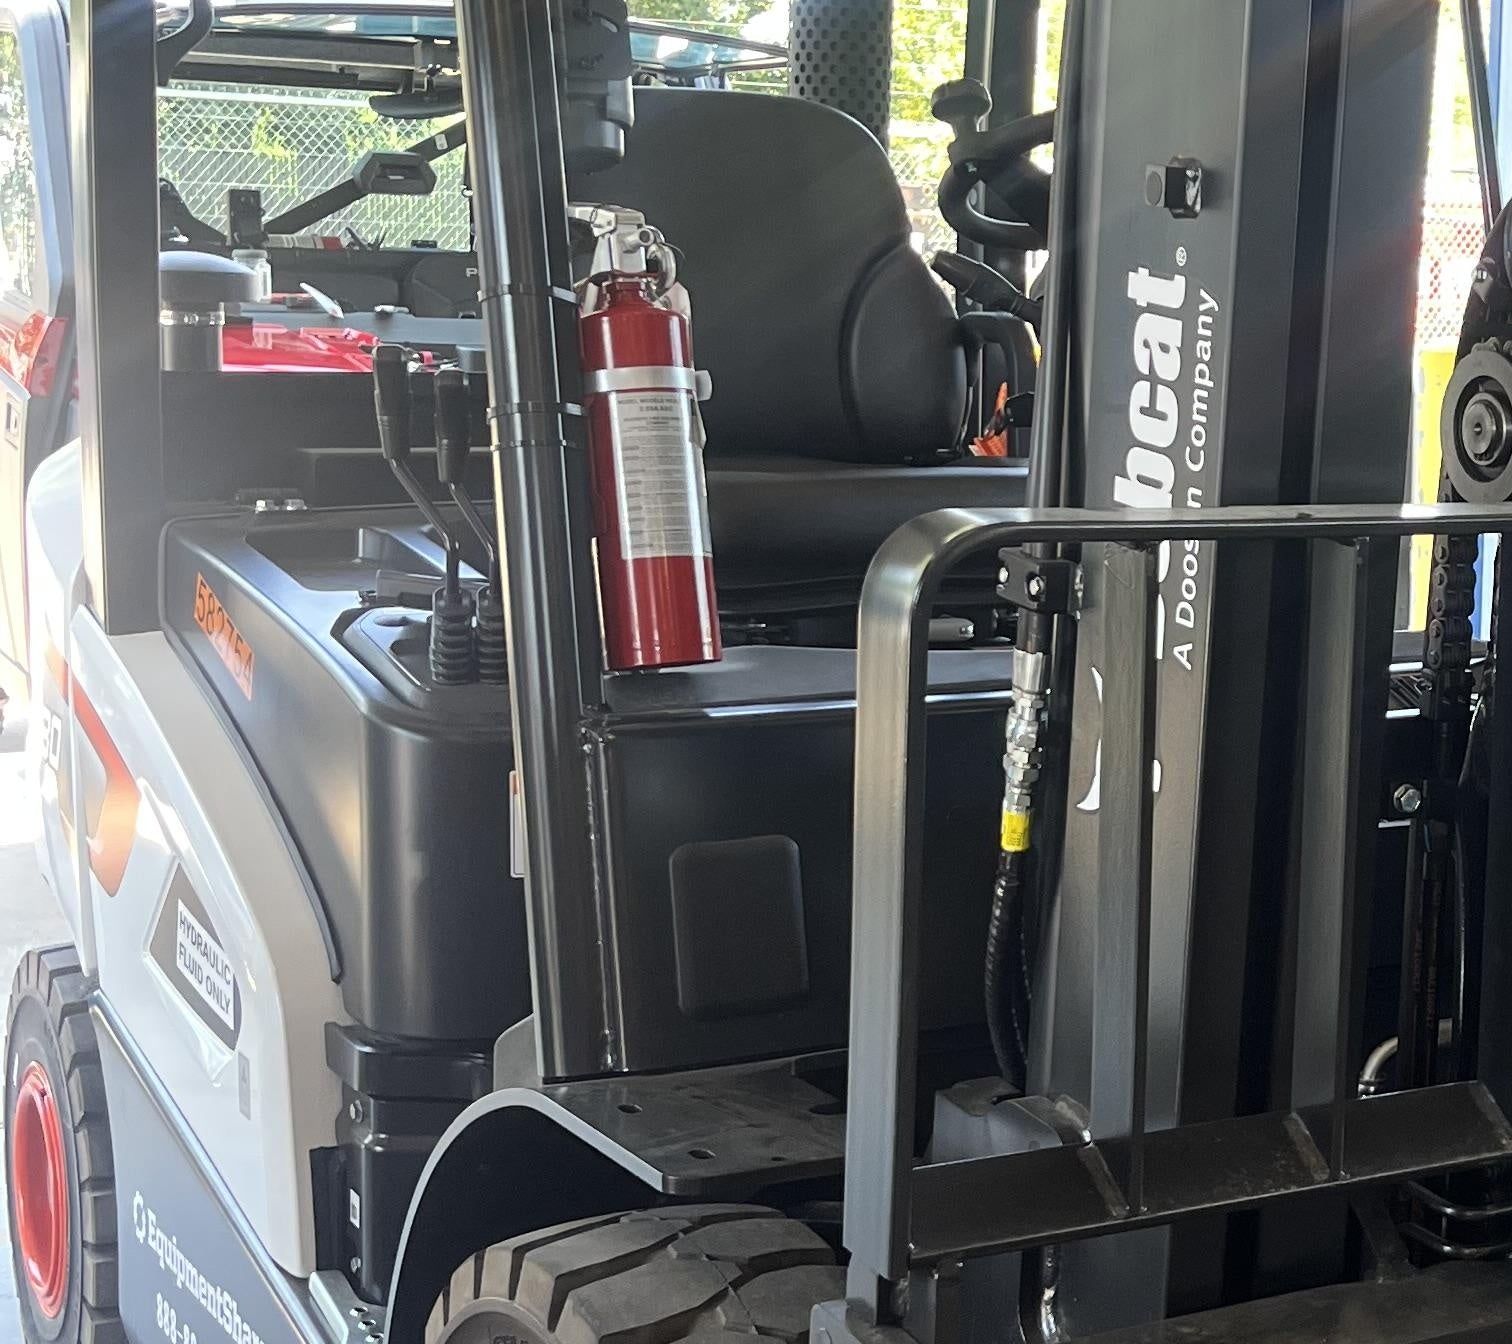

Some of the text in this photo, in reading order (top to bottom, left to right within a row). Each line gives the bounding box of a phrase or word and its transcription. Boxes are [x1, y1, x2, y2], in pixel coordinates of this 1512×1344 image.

[1172, 287, 1220, 670] A Doosn Company
[178, 942, 231, 1014] FLUID ONLY
[179, 911, 231, 985] HYDRAULIC
